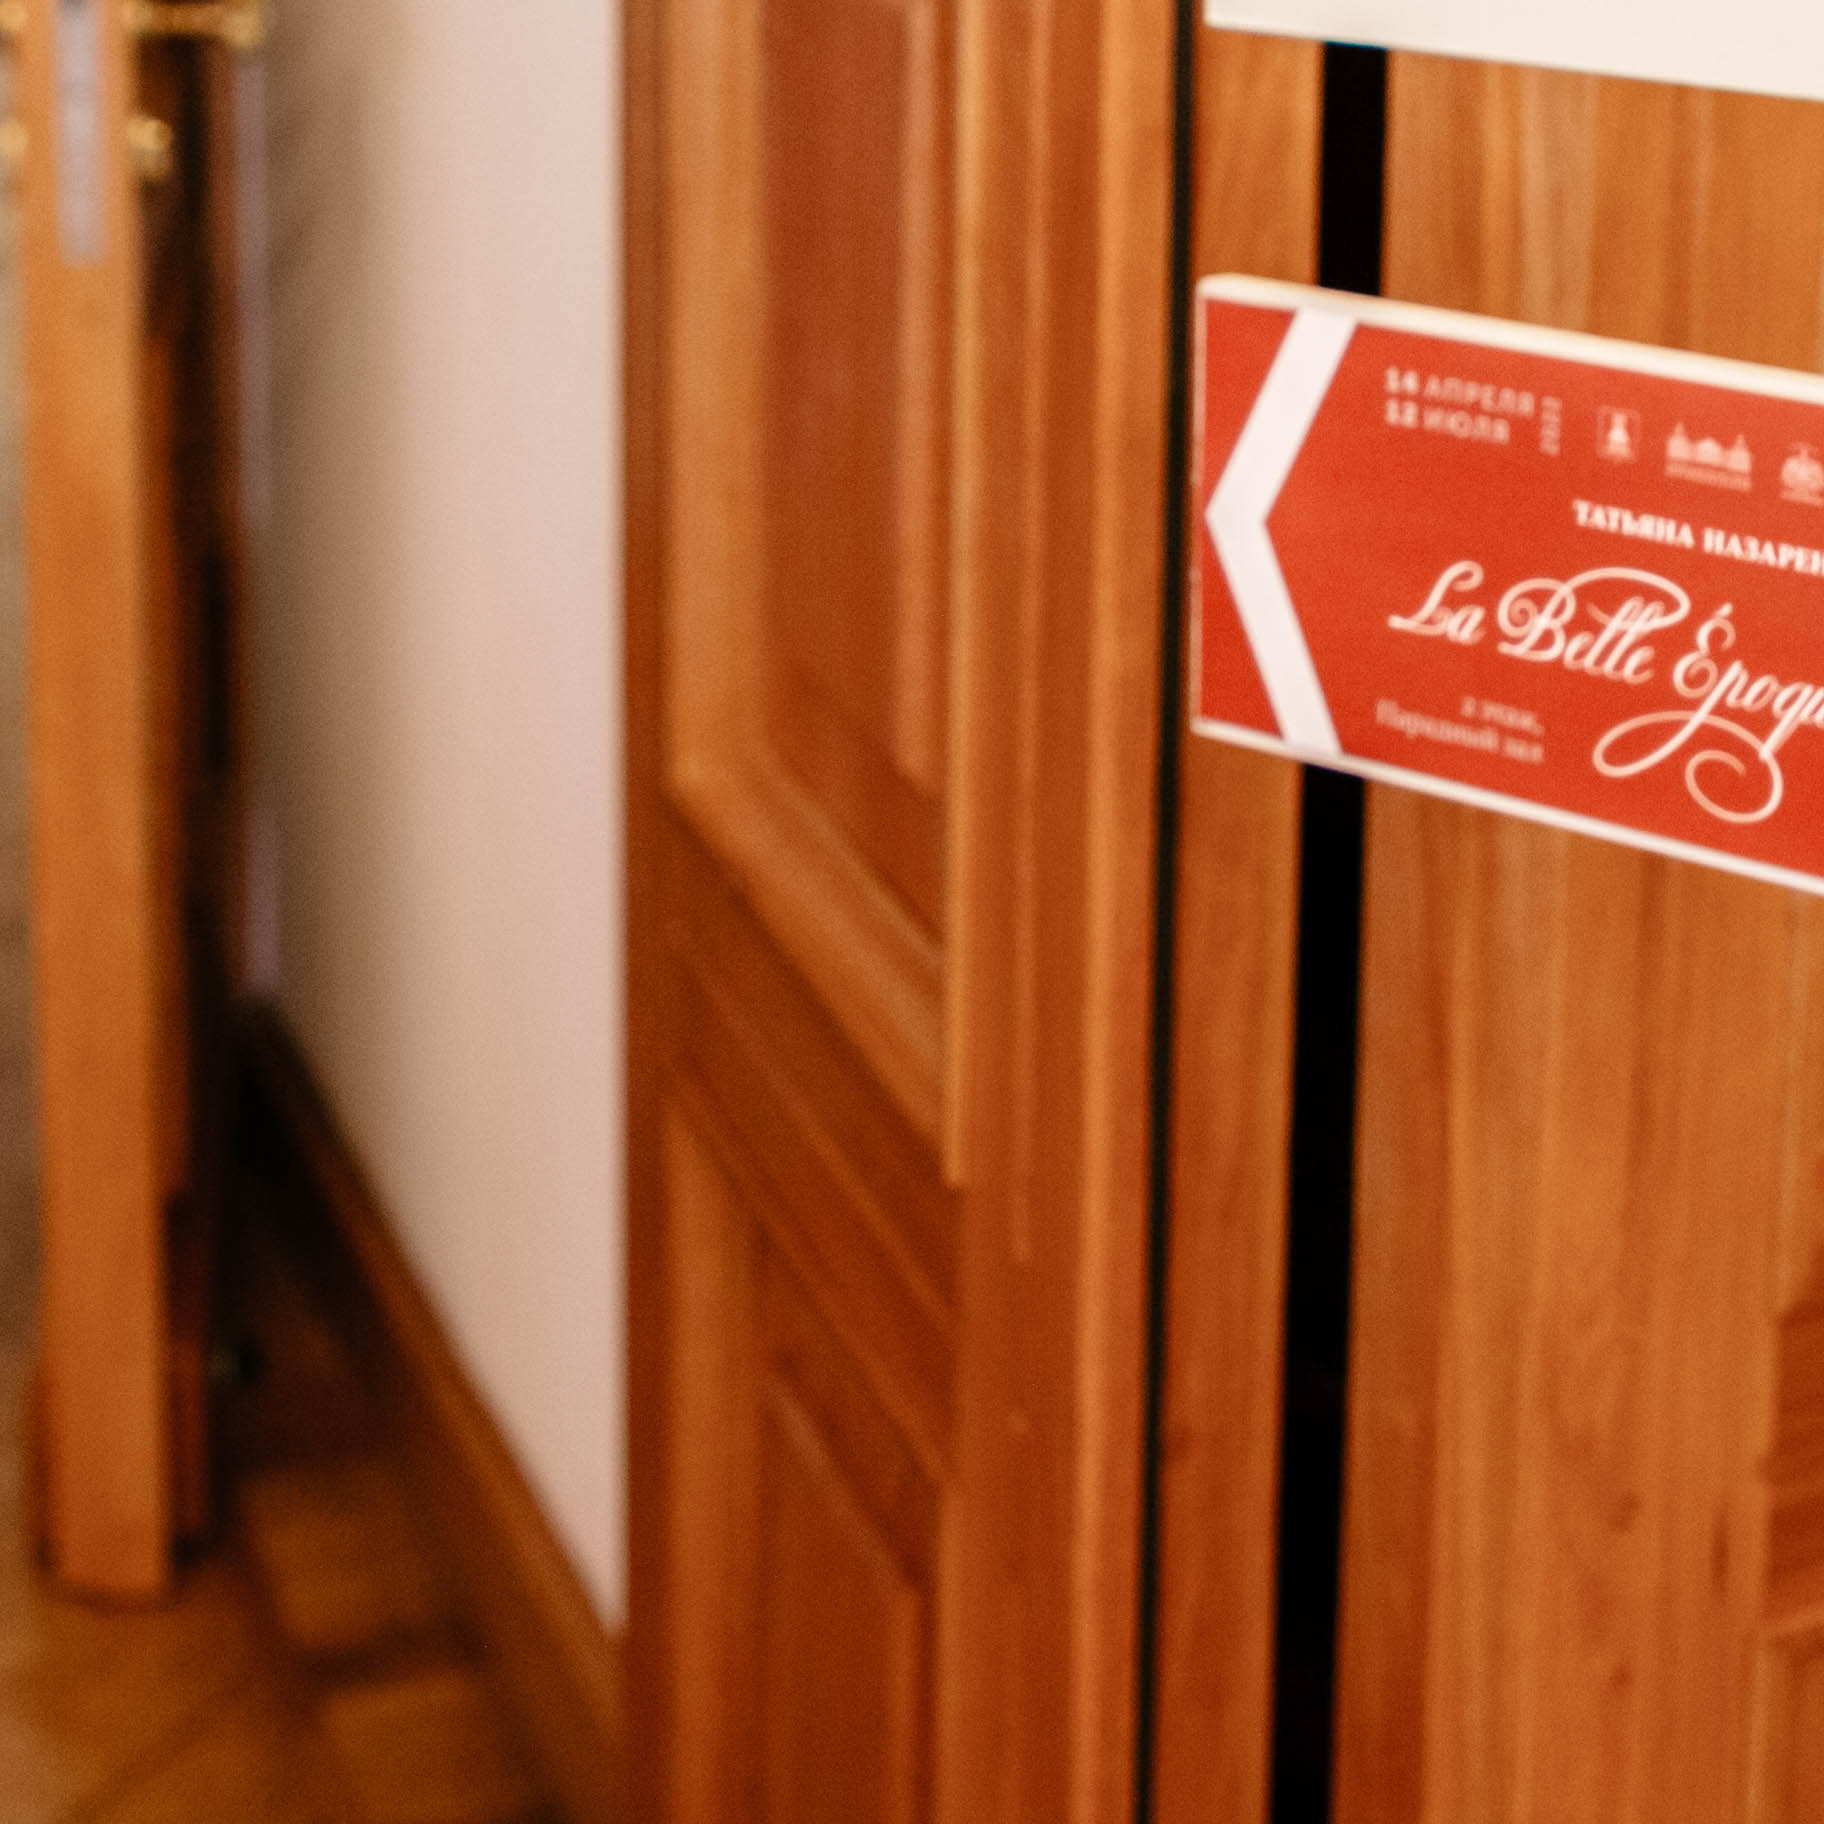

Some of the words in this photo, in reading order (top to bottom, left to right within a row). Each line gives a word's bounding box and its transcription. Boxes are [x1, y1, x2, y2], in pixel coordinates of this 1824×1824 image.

[1424, 374, 1535, 418] АПРЕЛЯ
[1423, 408, 1510, 445] ИЮЛЯ
[1573, 499, 1694, 548] ТАТЬЯНА
[1389, 561, 1485, 645] La
[1496, 566, 1691, 684] Belle
